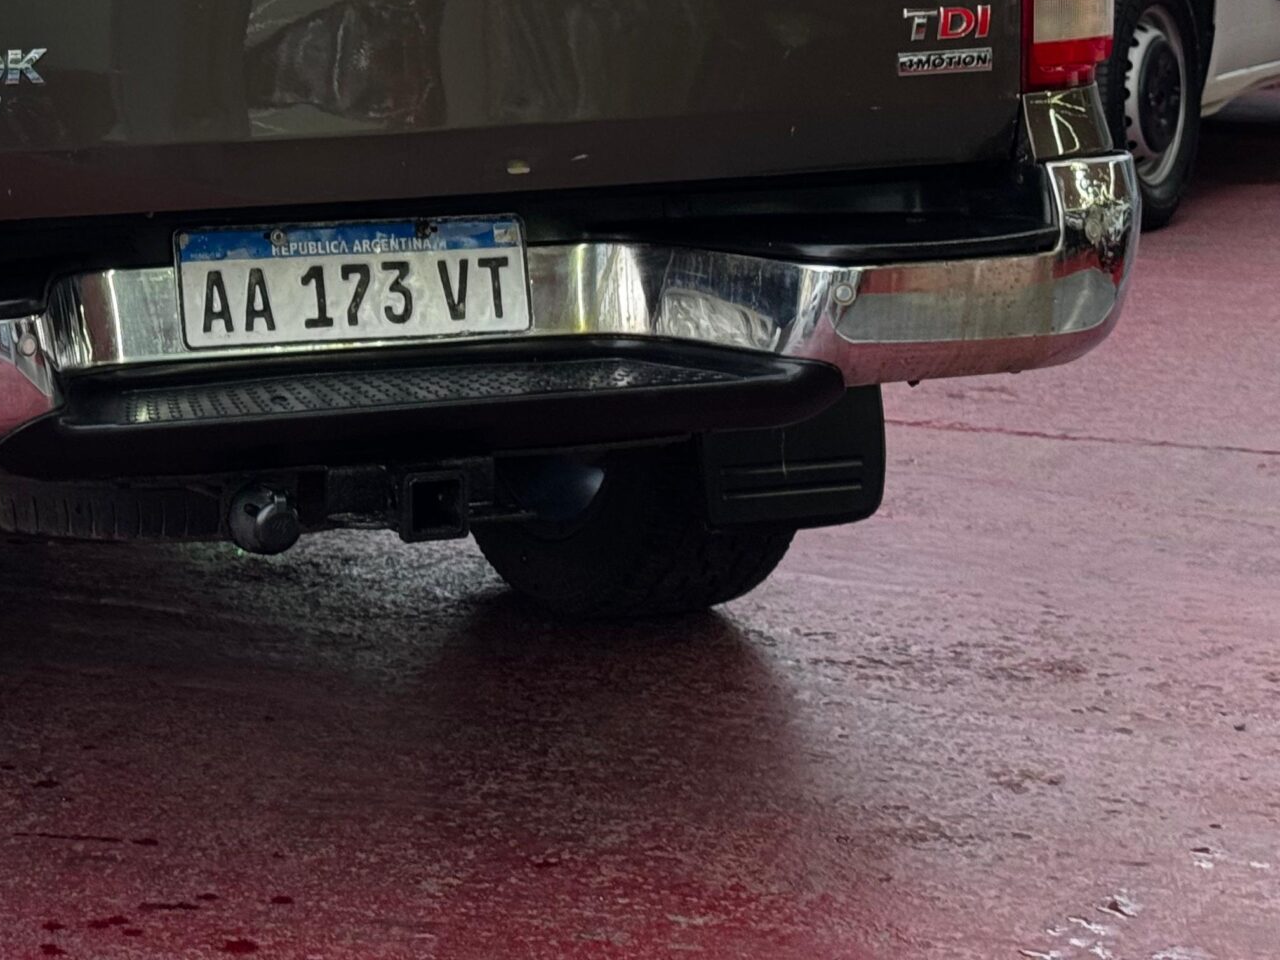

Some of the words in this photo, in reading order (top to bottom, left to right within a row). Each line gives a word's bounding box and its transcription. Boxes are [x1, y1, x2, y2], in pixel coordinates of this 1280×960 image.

[902, 4, 991, 42] TDI
[352, 236, 433, 254] ARGENTINA
[202, 268, 276, 333] AA
[300, 259, 414, 329] 173
[437, 256, 510, 321] VT
